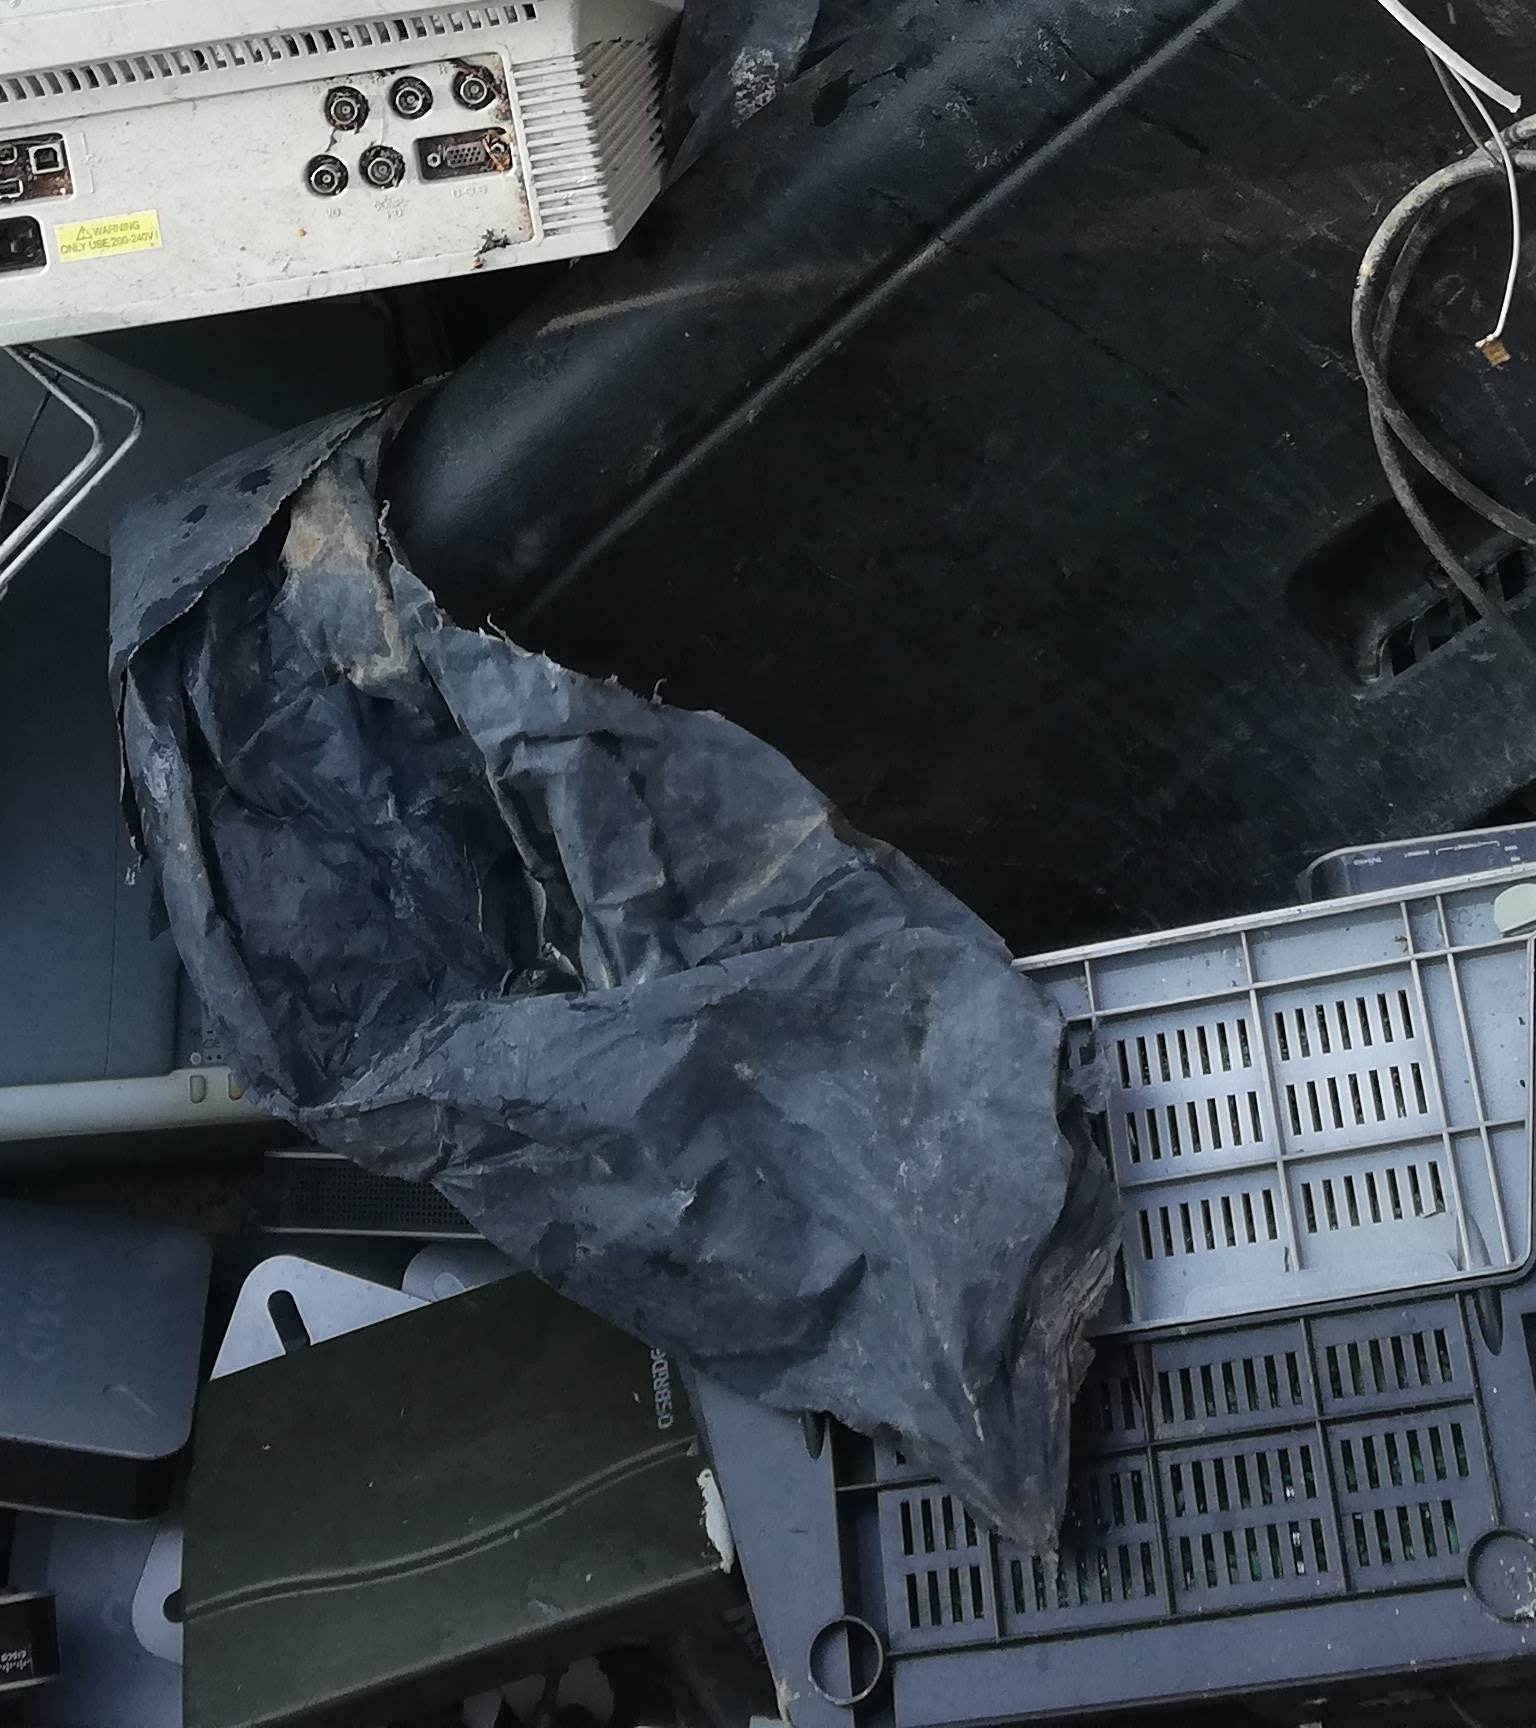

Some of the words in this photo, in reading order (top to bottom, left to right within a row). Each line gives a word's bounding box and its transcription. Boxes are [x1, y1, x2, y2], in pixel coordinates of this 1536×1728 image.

[93, 219, 142, 237] WARNING
[60, 242, 87, 255] ONLY
[88, 238, 110, 251] USE
[1, 1649, 26, 1662] CISCO
